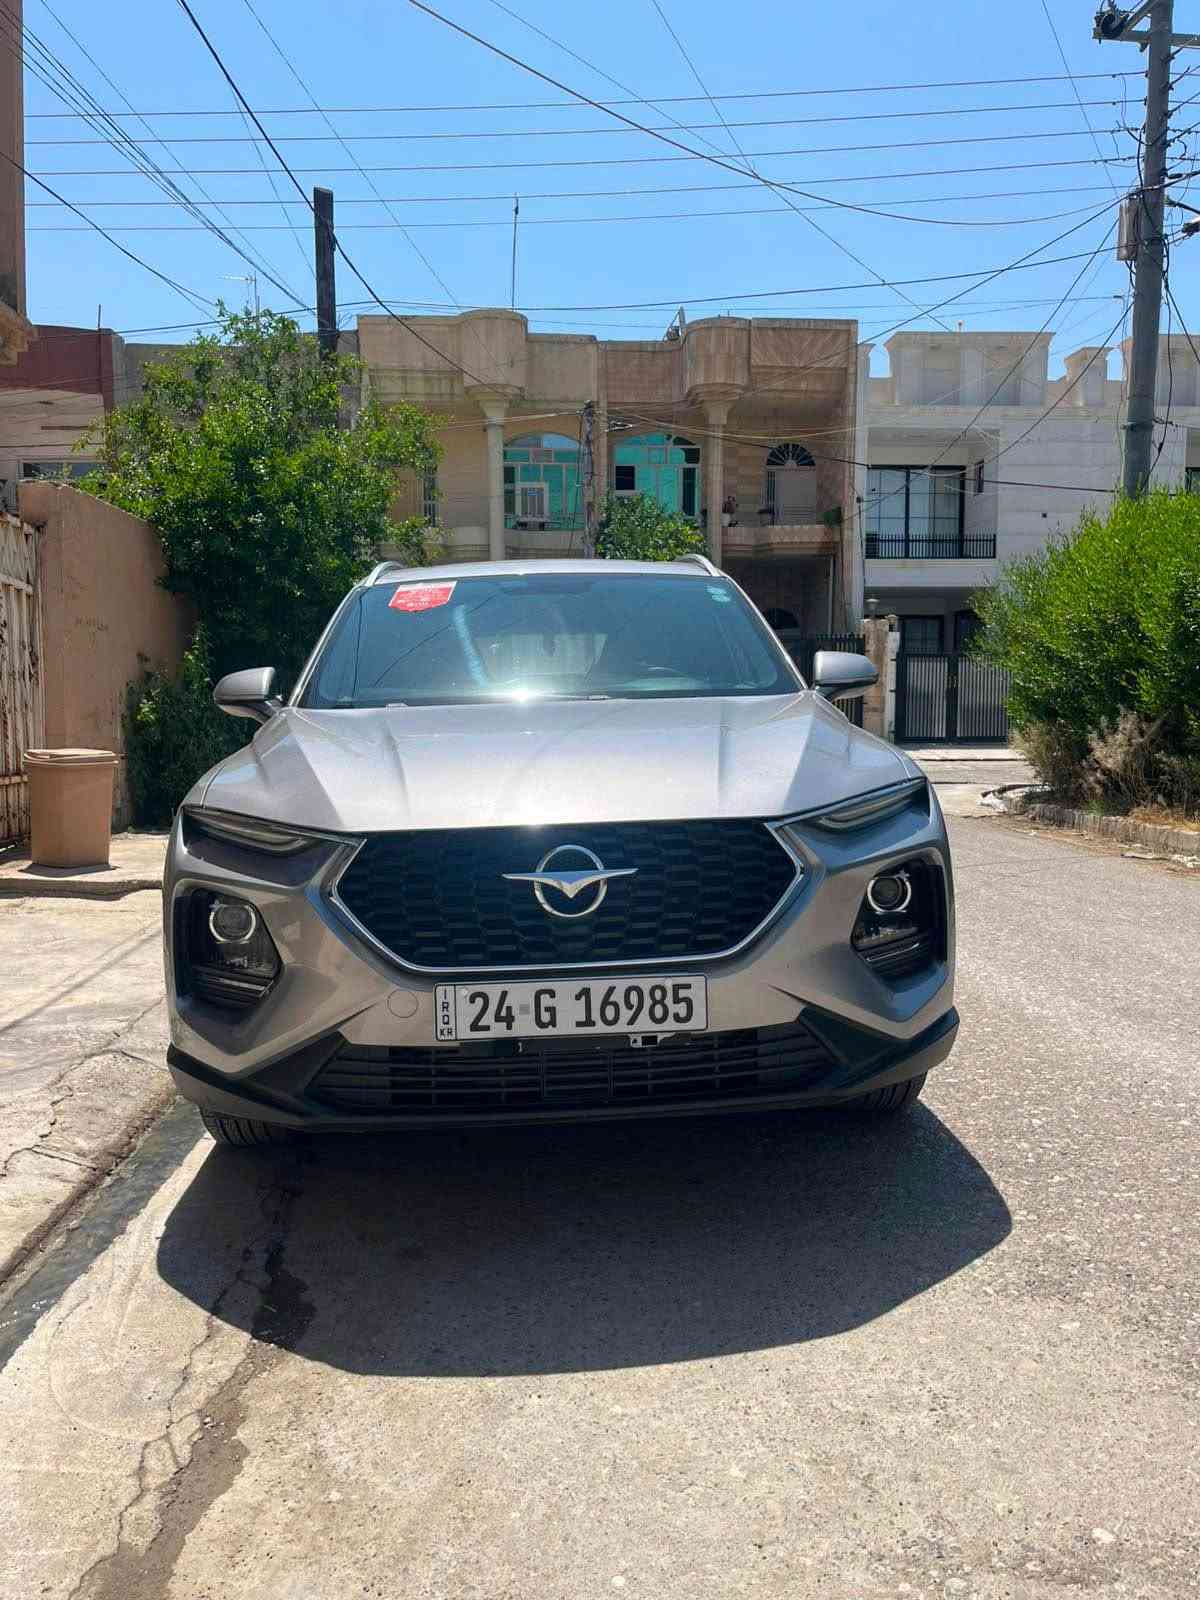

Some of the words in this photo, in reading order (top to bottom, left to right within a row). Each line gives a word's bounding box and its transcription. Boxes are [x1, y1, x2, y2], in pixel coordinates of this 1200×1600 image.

[469, 990, 515, 1032] 24
[534, 988, 557, 1029] G
[574, 984, 694, 1028] 16985
[439, 1028, 453, 1037] KR
